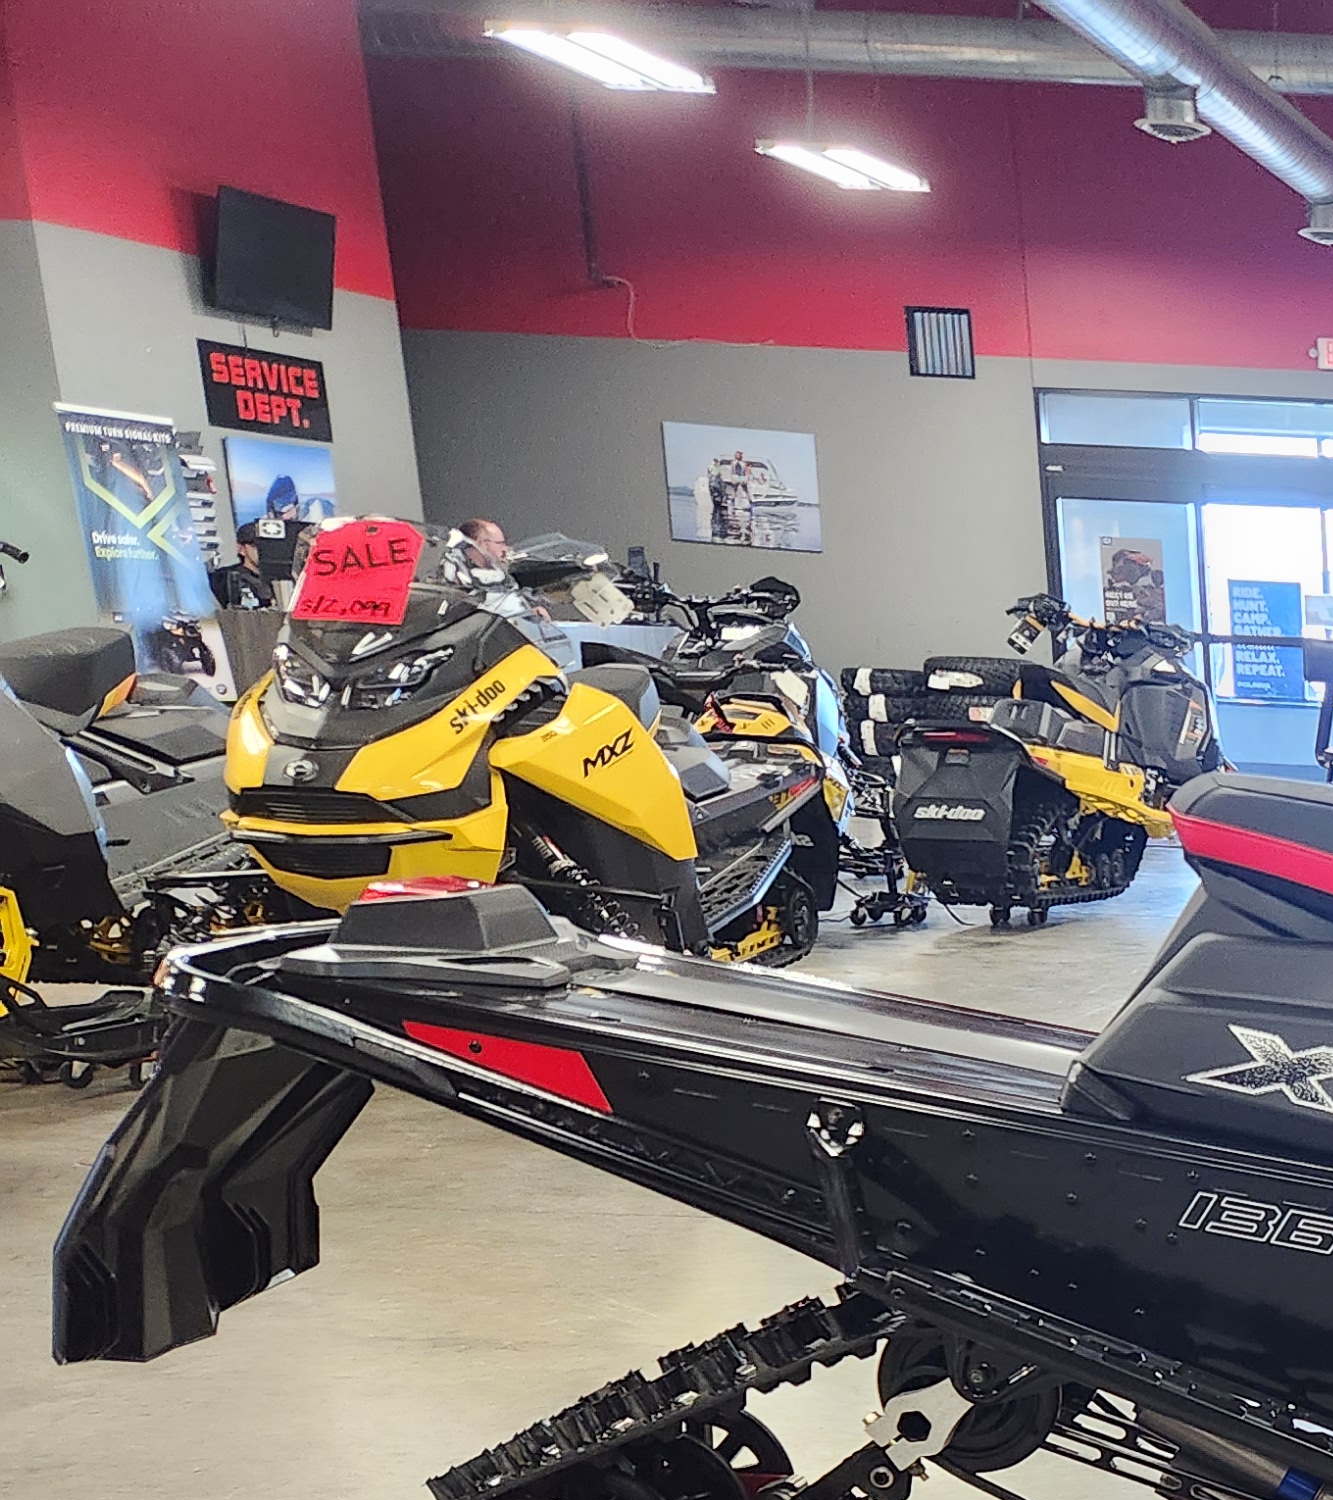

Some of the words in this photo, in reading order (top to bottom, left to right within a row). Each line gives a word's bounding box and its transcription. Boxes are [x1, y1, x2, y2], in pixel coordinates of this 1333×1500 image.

[209, 352, 319, 399] SERVICE
[236, 389, 311, 429] DEPT.
[103, 426, 124, 437] TURN
[312, 537, 415, 577] SALE
[1232, 587, 1265, 600] RIDE.
[1232, 599, 1269, 613] HUNT.
[1233, 611, 1273, 625] CAMP.
[1235, 650, 1281, 664] RELAX.
[1236, 663, 1286, 677] REPEAT.
[450, 679, 506, 735] ski-doo
[583, 726, 635, 779] MXZ
[914, 804, 986, 821] ski-doo
